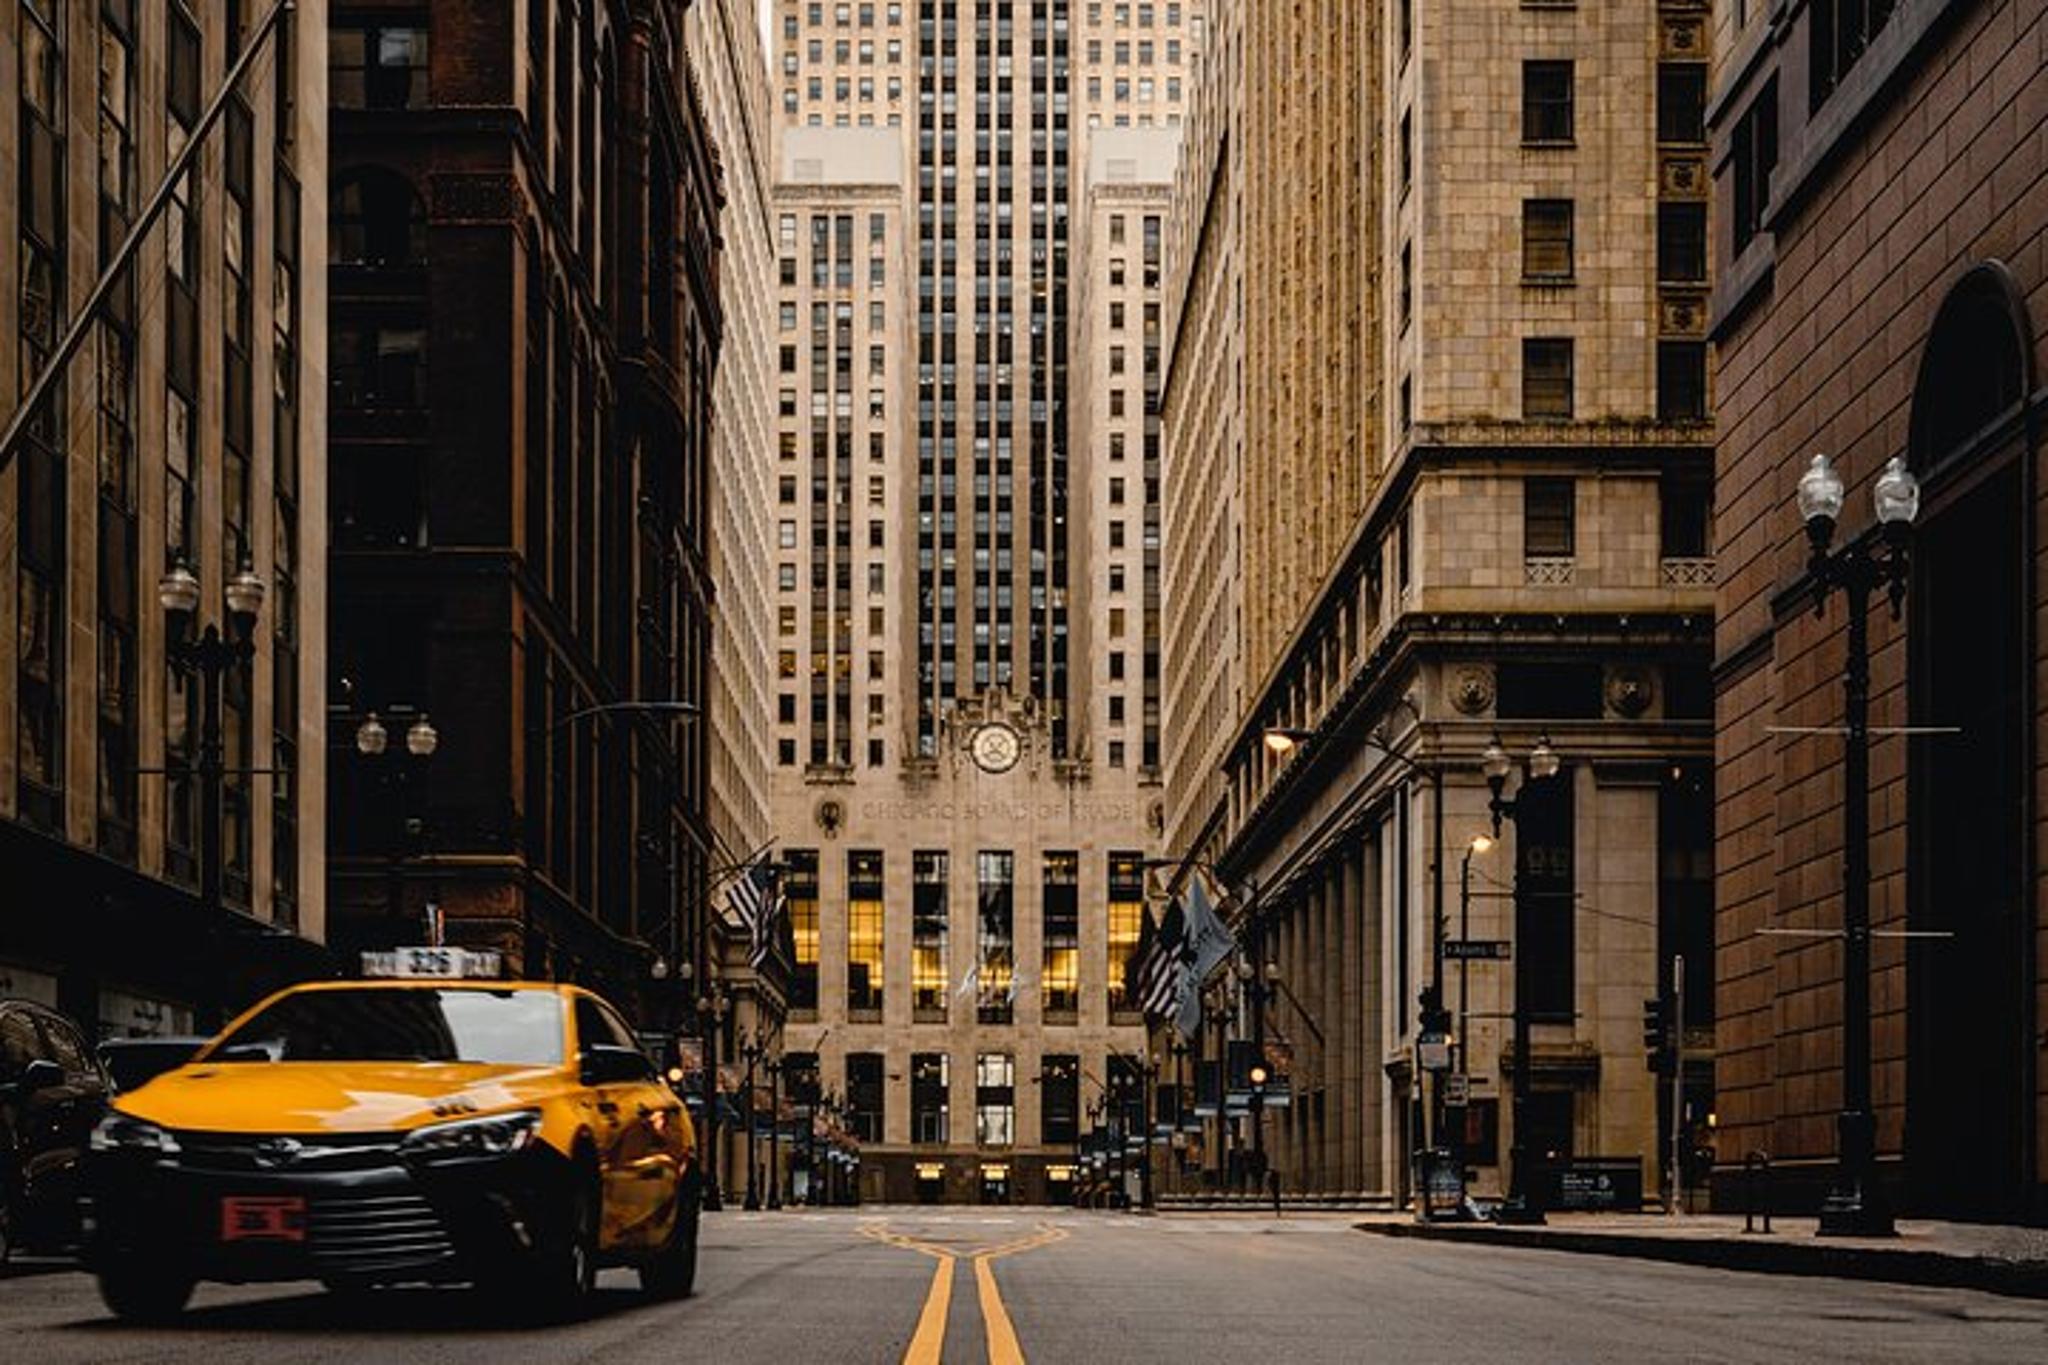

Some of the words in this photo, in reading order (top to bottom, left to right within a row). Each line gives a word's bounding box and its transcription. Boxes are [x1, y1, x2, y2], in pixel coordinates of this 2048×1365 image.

[862, 801, 956, 820] CHICAGO
[963, 801, 1029, 820] BOARD
[1037, 801, 1063, 820] OF
[1073, 801, 1133, 820] TRADE
